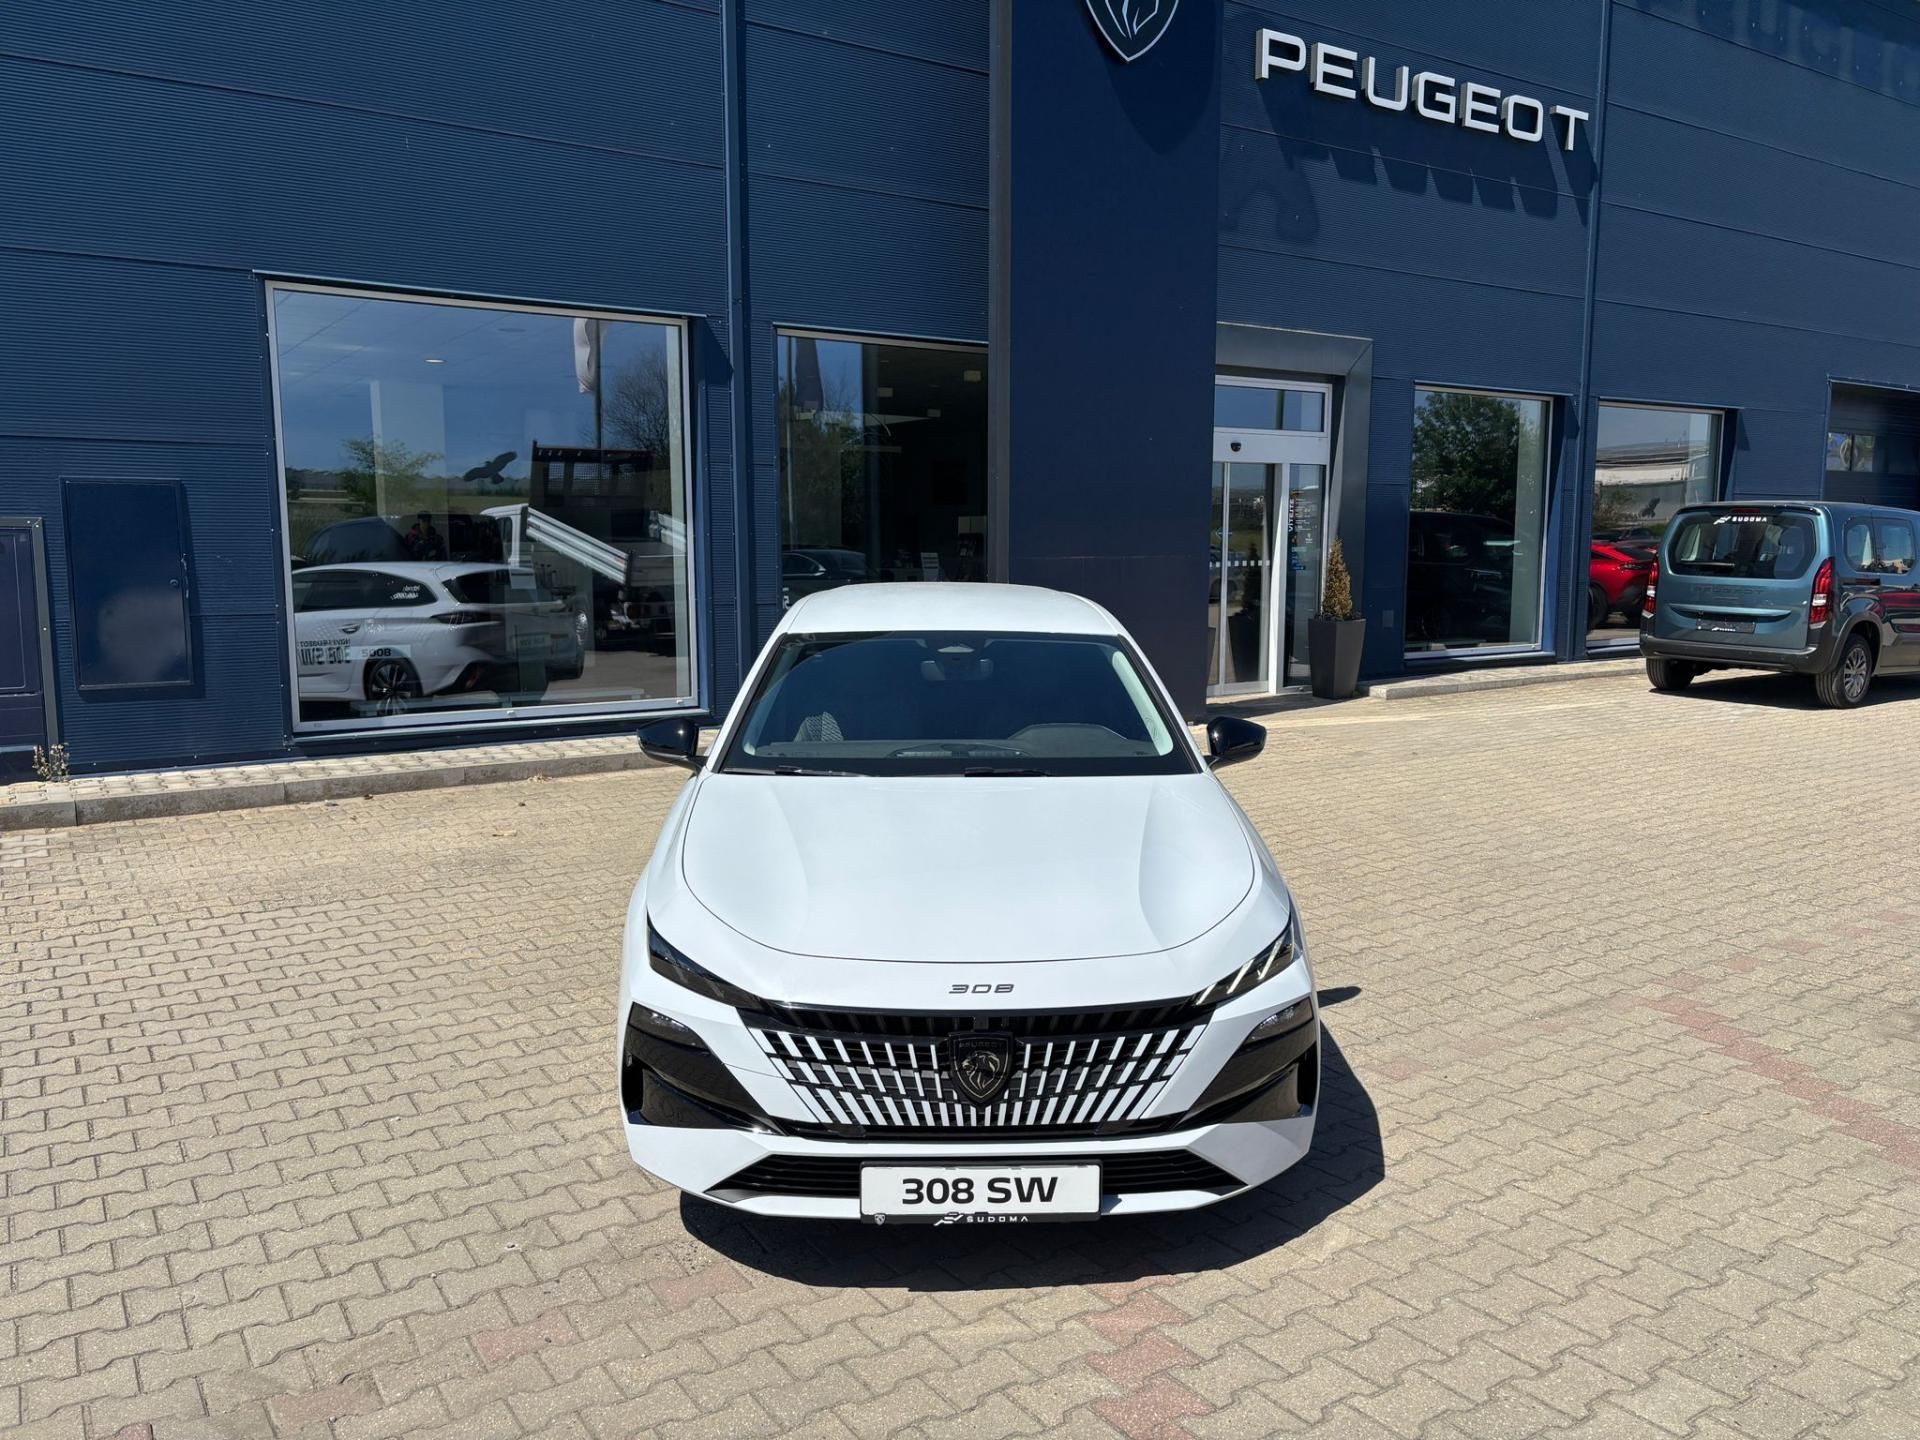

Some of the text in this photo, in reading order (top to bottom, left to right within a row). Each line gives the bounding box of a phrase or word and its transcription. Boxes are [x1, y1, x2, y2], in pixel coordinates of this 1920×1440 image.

[1255, 28, 1589, 151] PEUGEOT
[948, 984, 1014, 994] 308
[902, 1177, 1058, 1205] 308 SW
[966, 1215, 1028, 1223] SUDOMA
